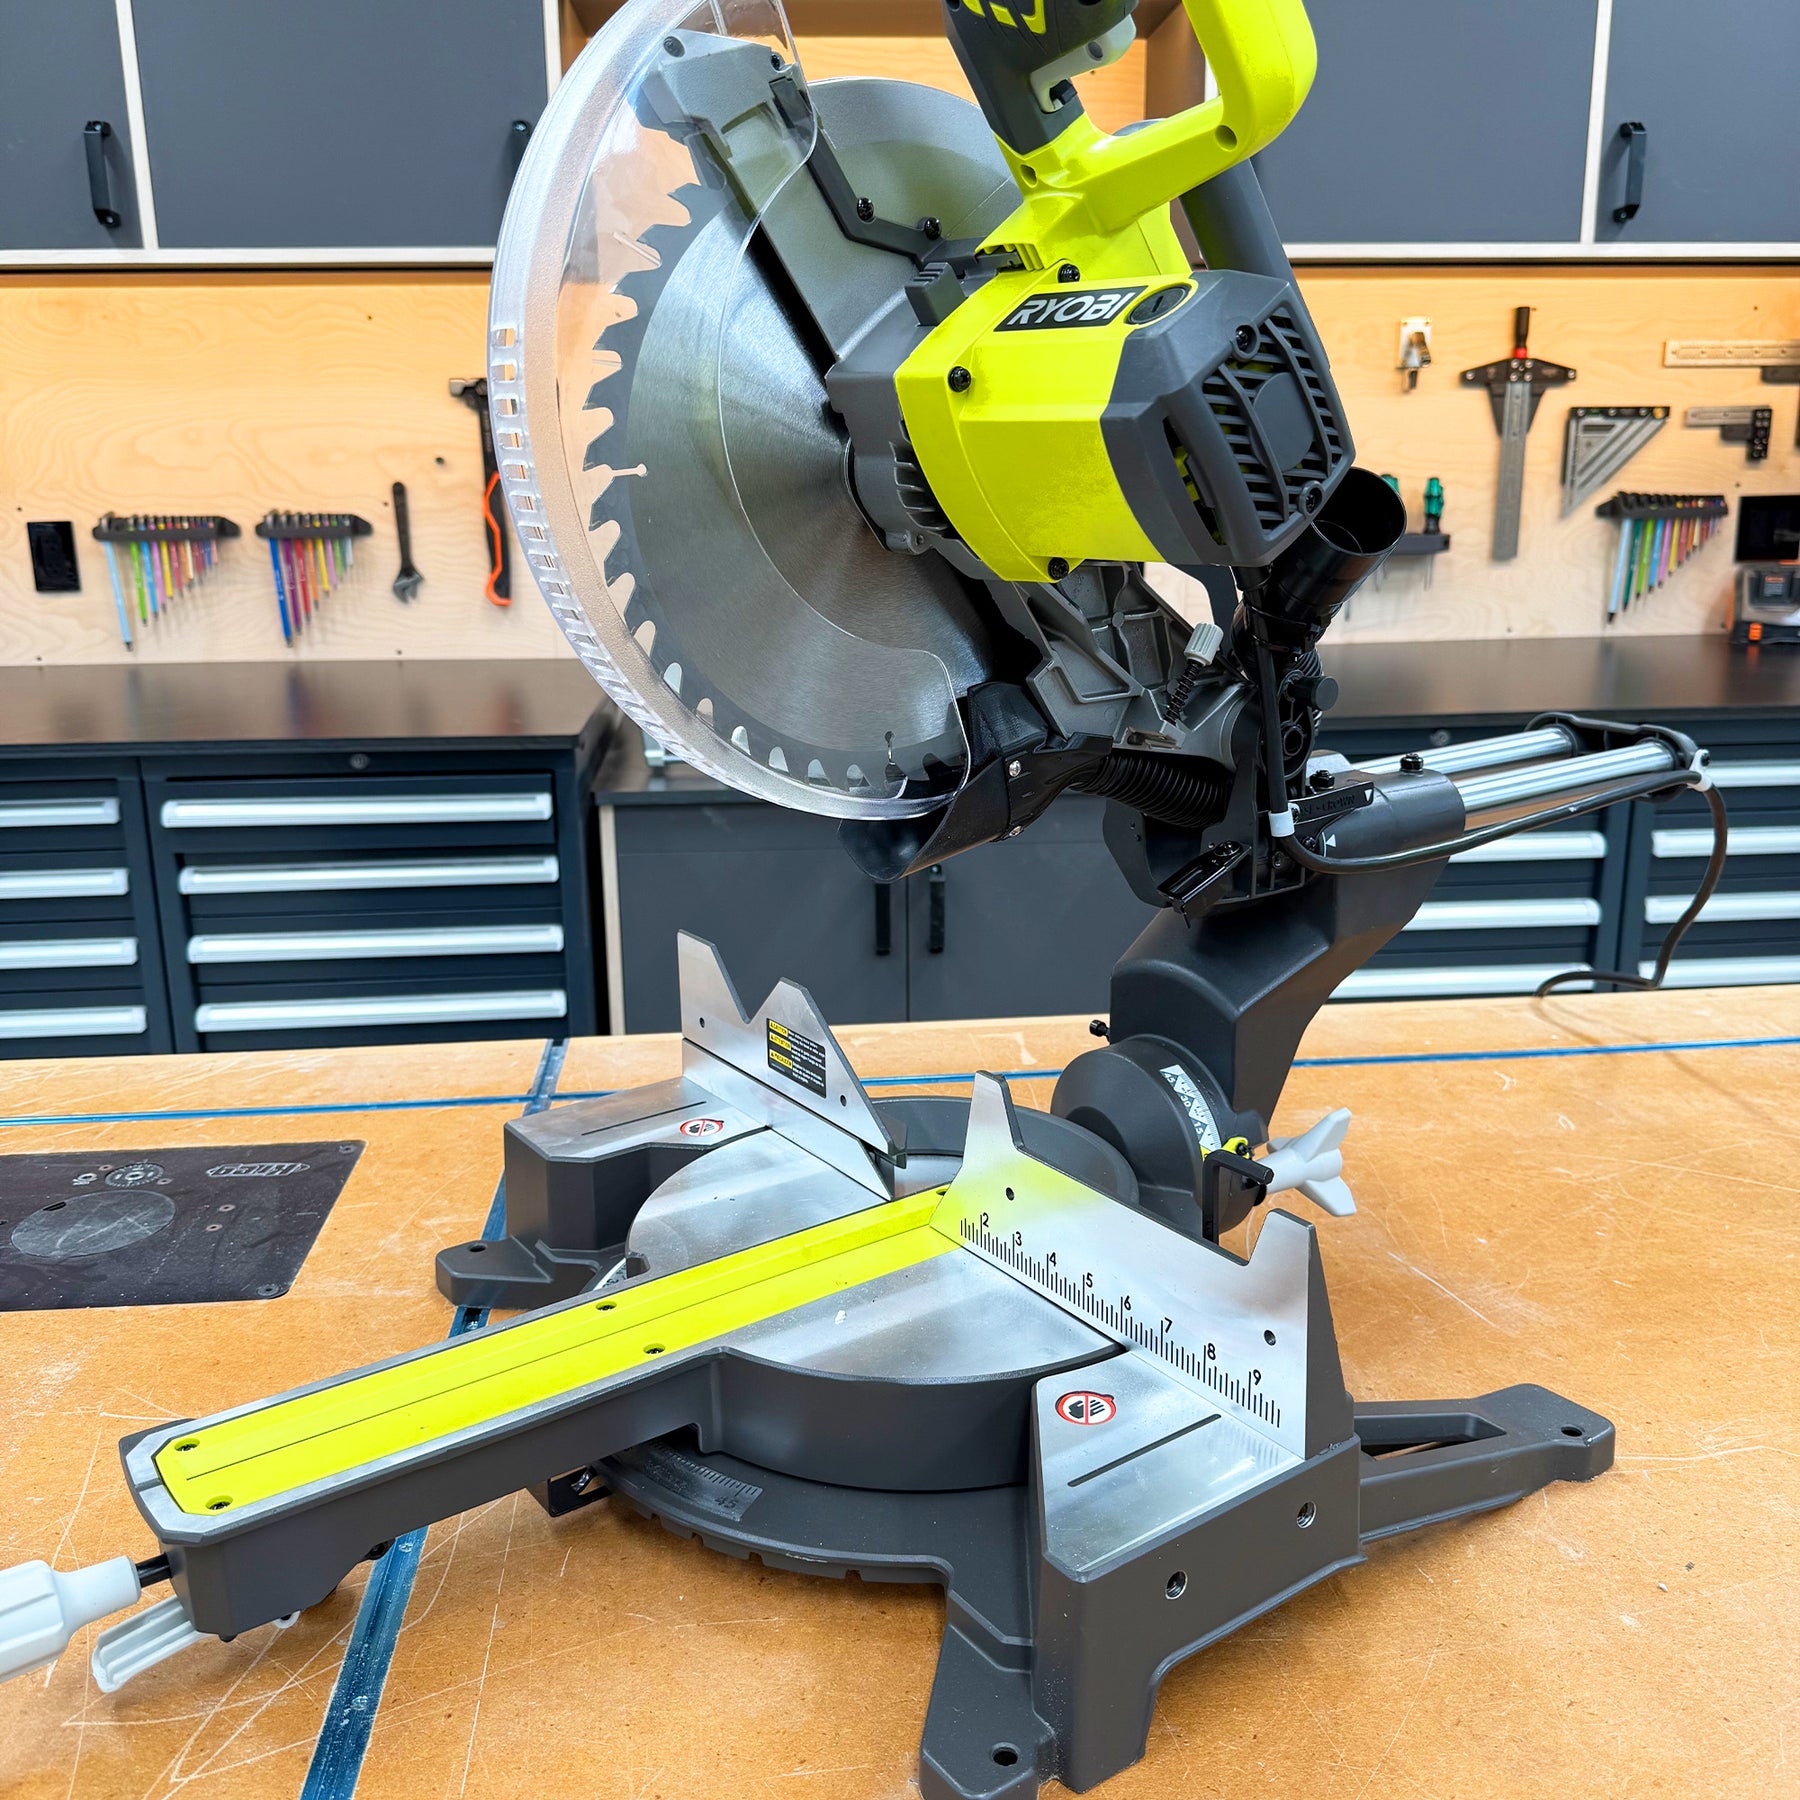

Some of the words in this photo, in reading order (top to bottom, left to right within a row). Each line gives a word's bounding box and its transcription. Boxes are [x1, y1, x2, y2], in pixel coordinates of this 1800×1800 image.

[1006, 292, 1136, 326] RYOBI
[1164, 1072, 1175, 1083] 45
[1180, 1095, 1192, 1108] 30
[1194, 1122, 1204, 1134] 15
[982, 1212, 989, 1227] 2
[1015, 1231, 1022, 1247] 3
[1049, 1252, 1057, 1267] 4
[1086, 1272, 1093, 1288] 5
[1124, 1295, 1131, 1311] 6
[1164, 1317, 1173, 1333] 7
[1207, 1343, 1216, 1360] 8
[1253, 1369, 1262, 1386] 9
[714, 1496, 738, 1509] 45
